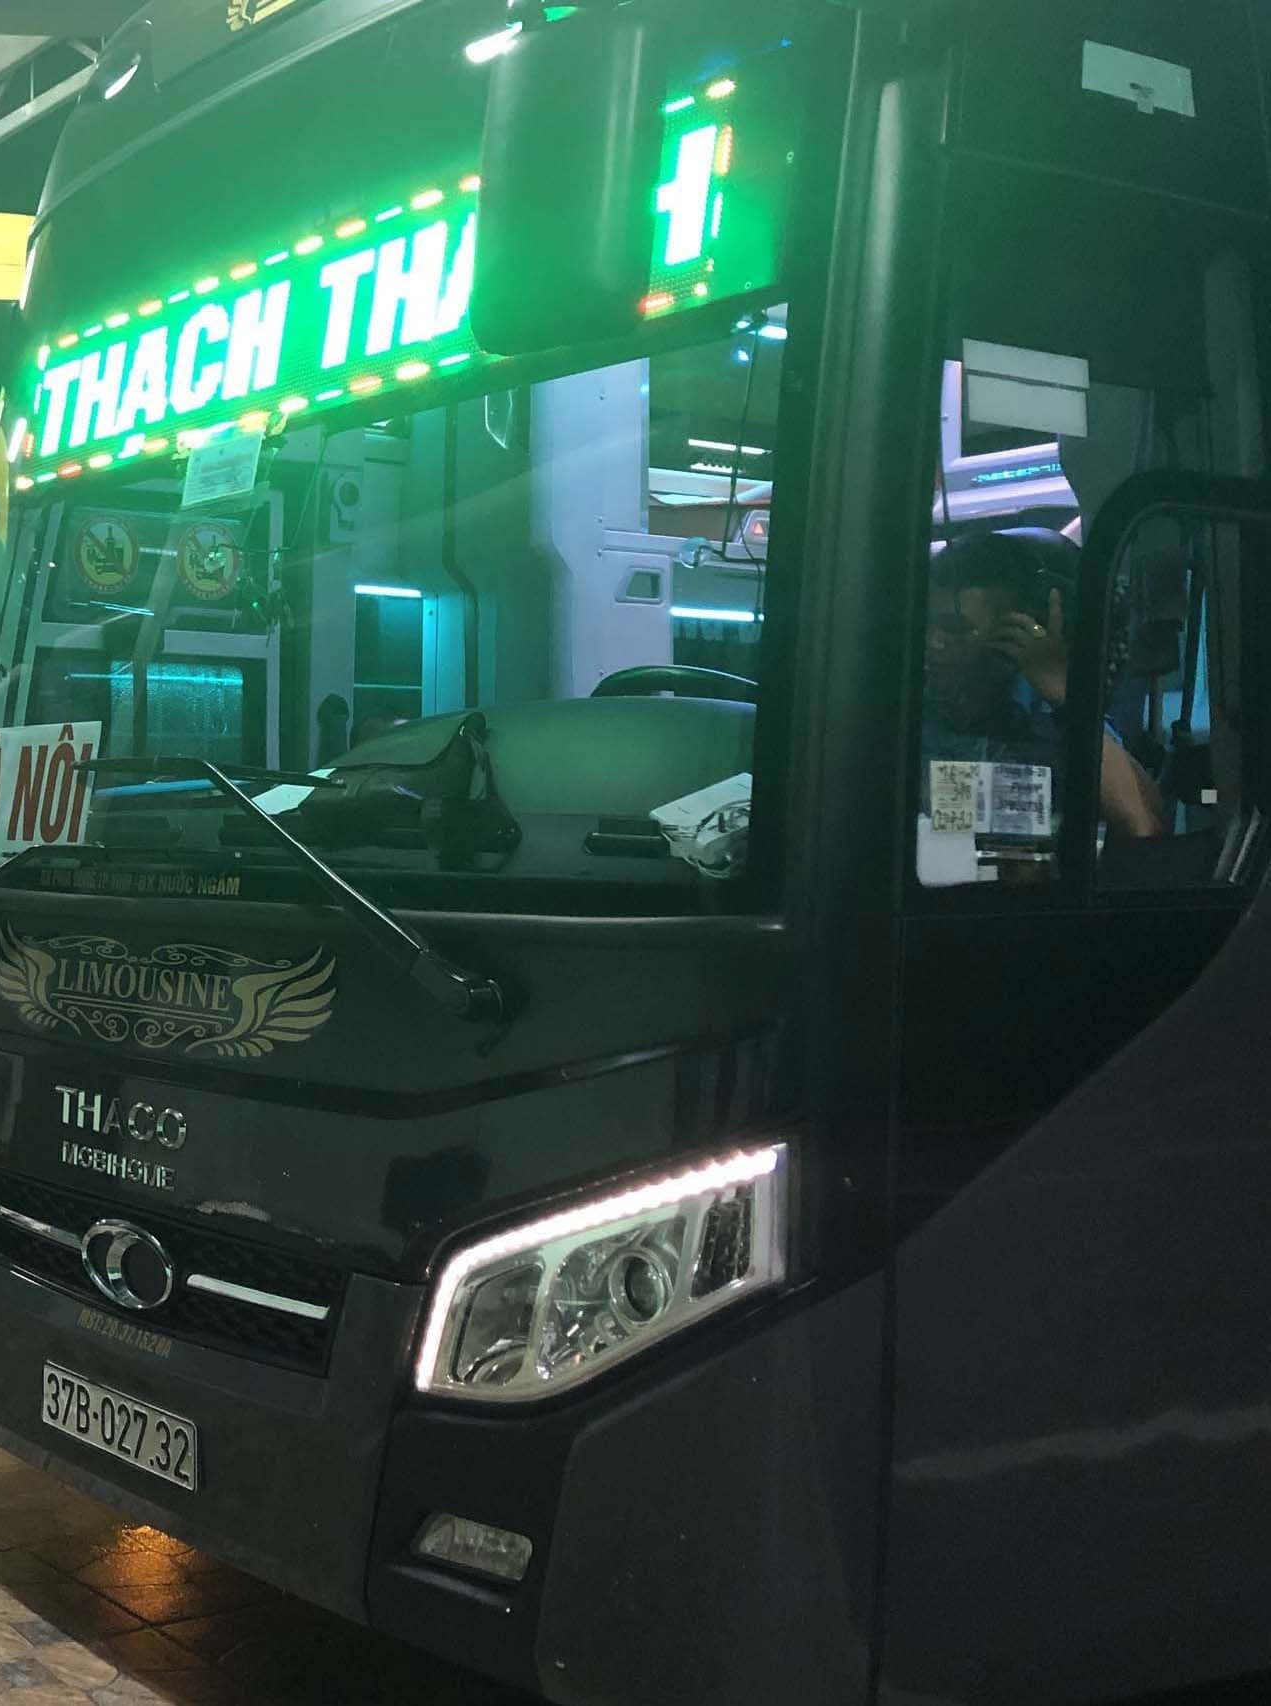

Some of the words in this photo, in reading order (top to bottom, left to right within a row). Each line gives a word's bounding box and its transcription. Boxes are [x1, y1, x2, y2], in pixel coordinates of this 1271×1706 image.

[58, 959, 233, 1013] LIMOUSINE
[55, 1085, 187, 1149] THACO
[61, 1140, 177, 1191] MOBIHOME
